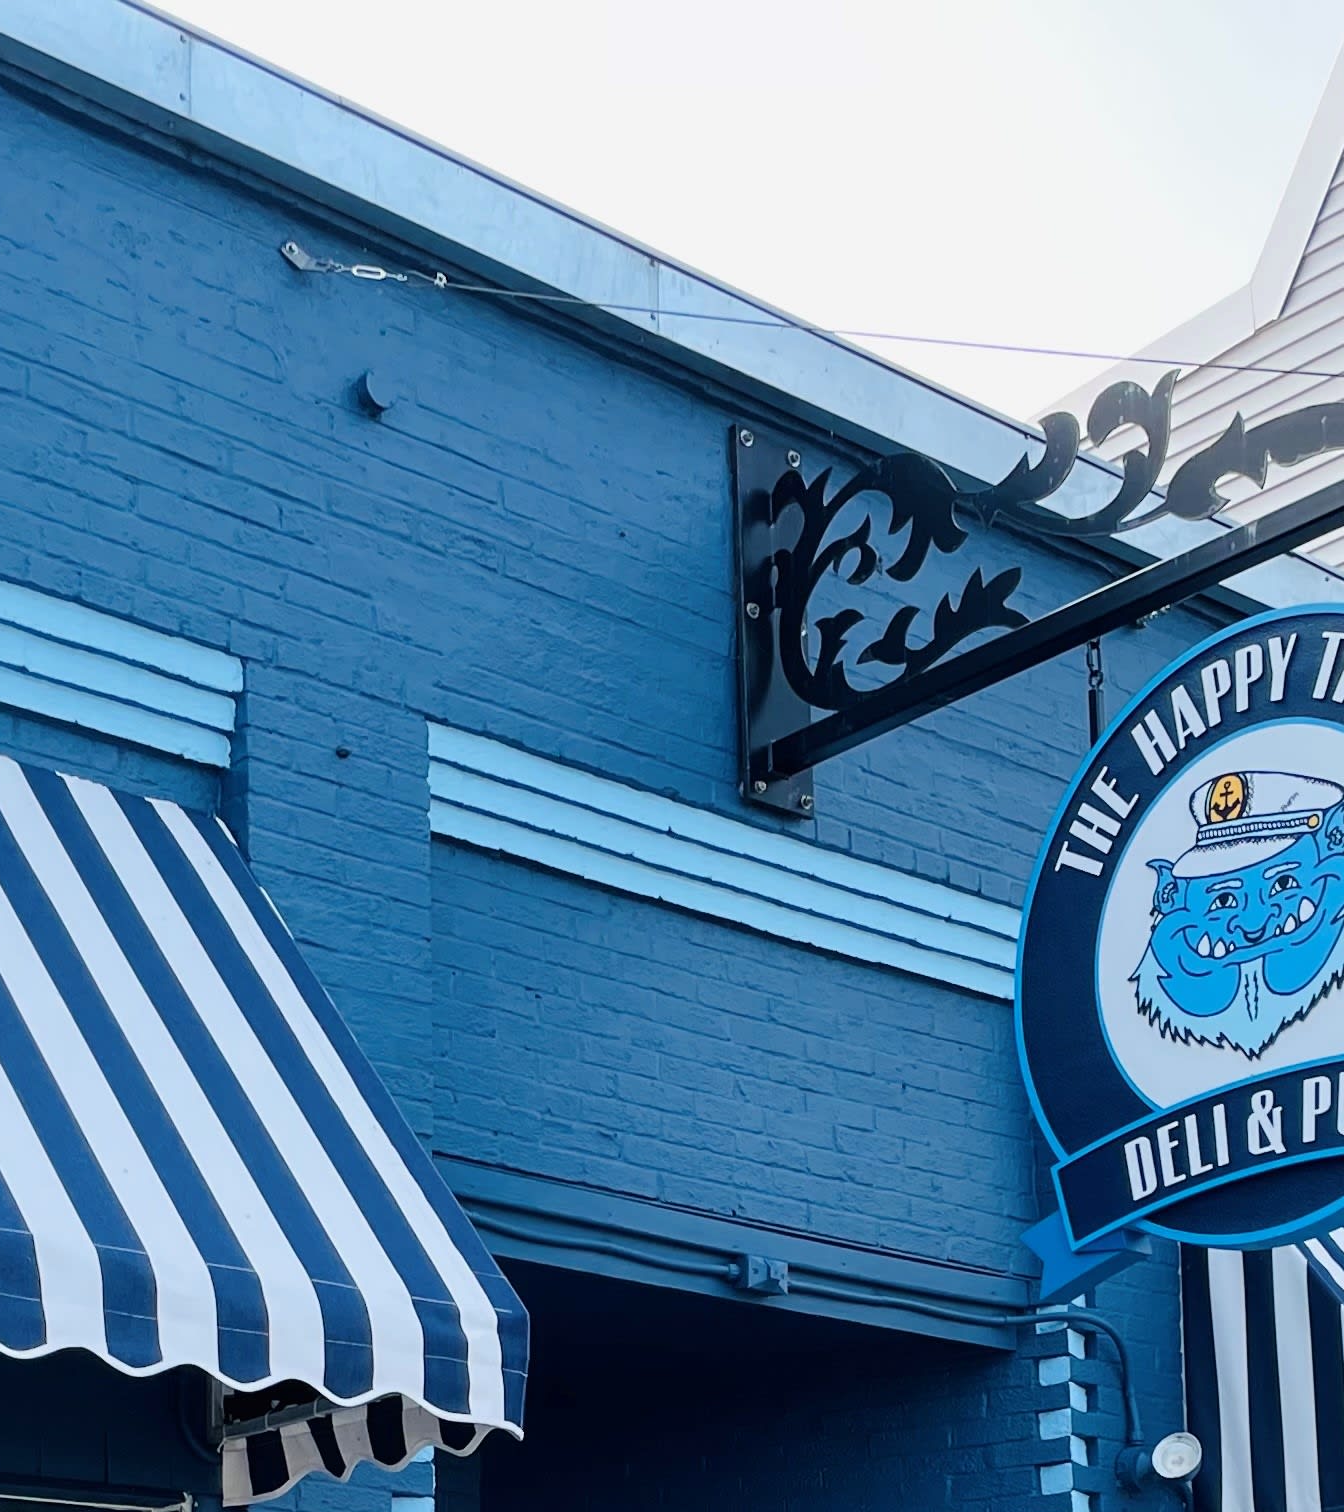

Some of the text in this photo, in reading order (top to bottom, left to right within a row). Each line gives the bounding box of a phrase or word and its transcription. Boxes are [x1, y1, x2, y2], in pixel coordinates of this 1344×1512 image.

[1054, 765, 1140, 879] THE
[1129, 632, 1299, 777] HAPPY
[1122, 1118, 1230, 1203] DELI
[1246, 1088, 1287, 1155] &
